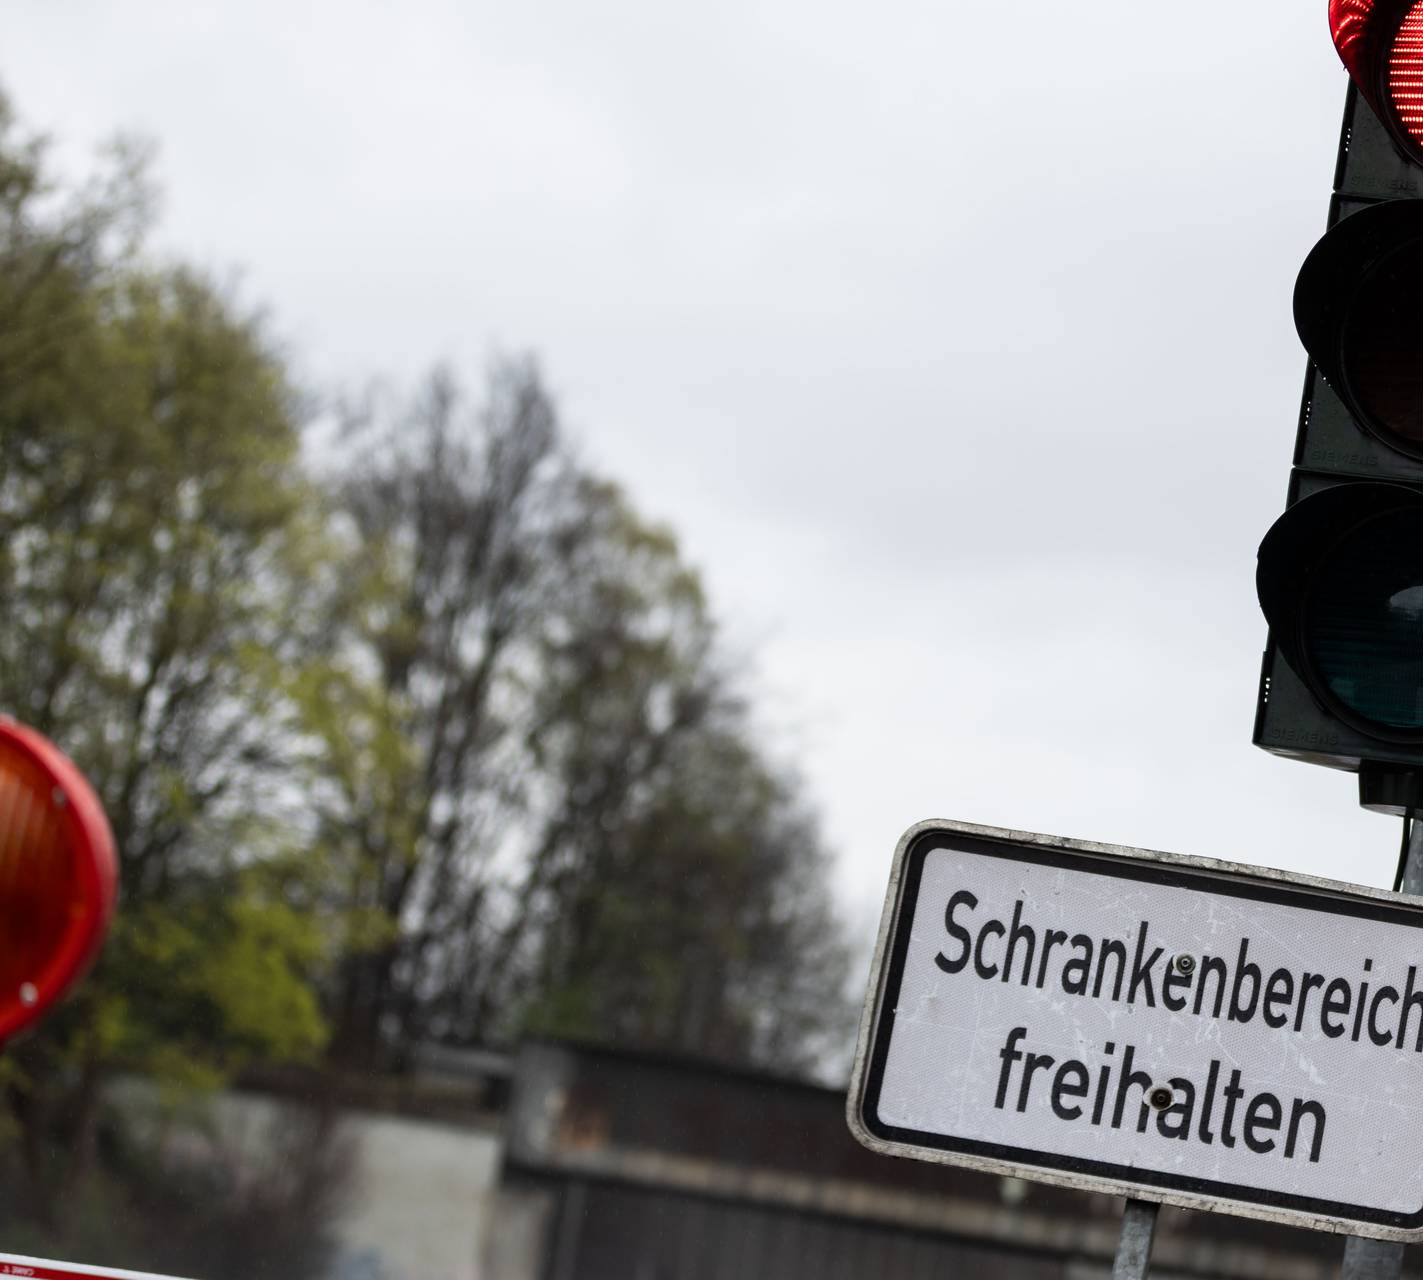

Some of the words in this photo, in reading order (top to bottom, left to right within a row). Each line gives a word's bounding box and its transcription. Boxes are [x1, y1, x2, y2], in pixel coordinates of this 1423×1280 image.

[1312, 449, 1378, 466] SIEMENS
[1271, 725, 1339, 745] SIEMENS
[995, 1027, 1326, 1162] freihalten
